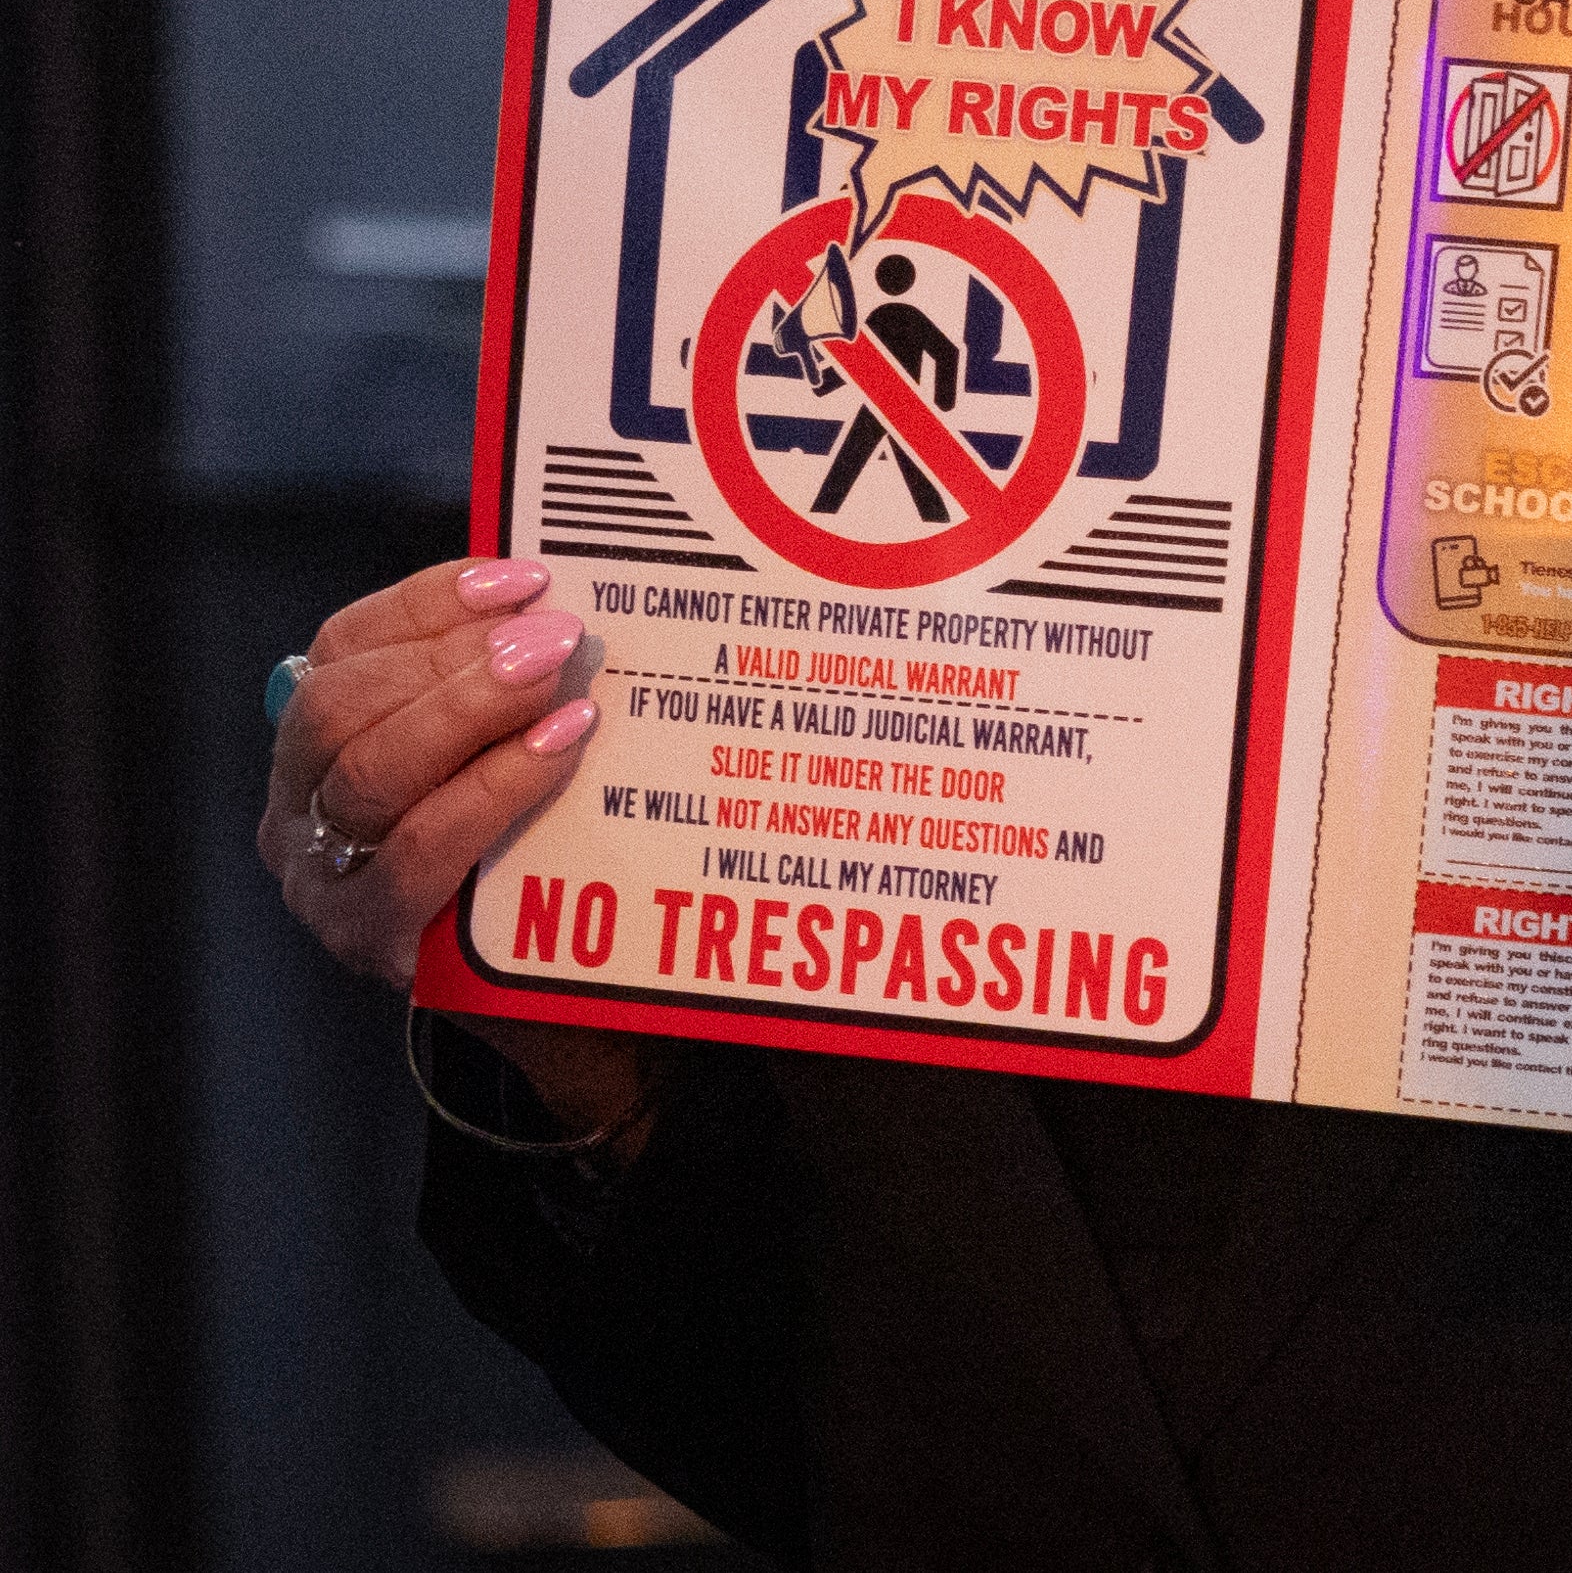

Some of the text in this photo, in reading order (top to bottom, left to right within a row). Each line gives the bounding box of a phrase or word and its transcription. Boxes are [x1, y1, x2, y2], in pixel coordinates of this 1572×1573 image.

[820, 67, 1215, 156] MY RIGHTS
[589, 580, 1153, 662] YOU CANNOT ENTER PRIVATE PROPERTY WITHOUT
[713, 642, 1020, 702] A VALID JUDICAL WARRANT
[629, 685, 1094, 764] IF YOU HAVE A VALID JUDICIAL WARRANT,
[709, 744, 1006, 804] SLIDE IT UNDER THE DOOR
[601, 784, 1105, 865] WE WILLL NOT ANSWER ANY QUESTIONS AND
[702, 846, 998, 907] I WILL CALL MY ATTORNEY
[510, 871, 1170, 1031] NO TRESPASSING
